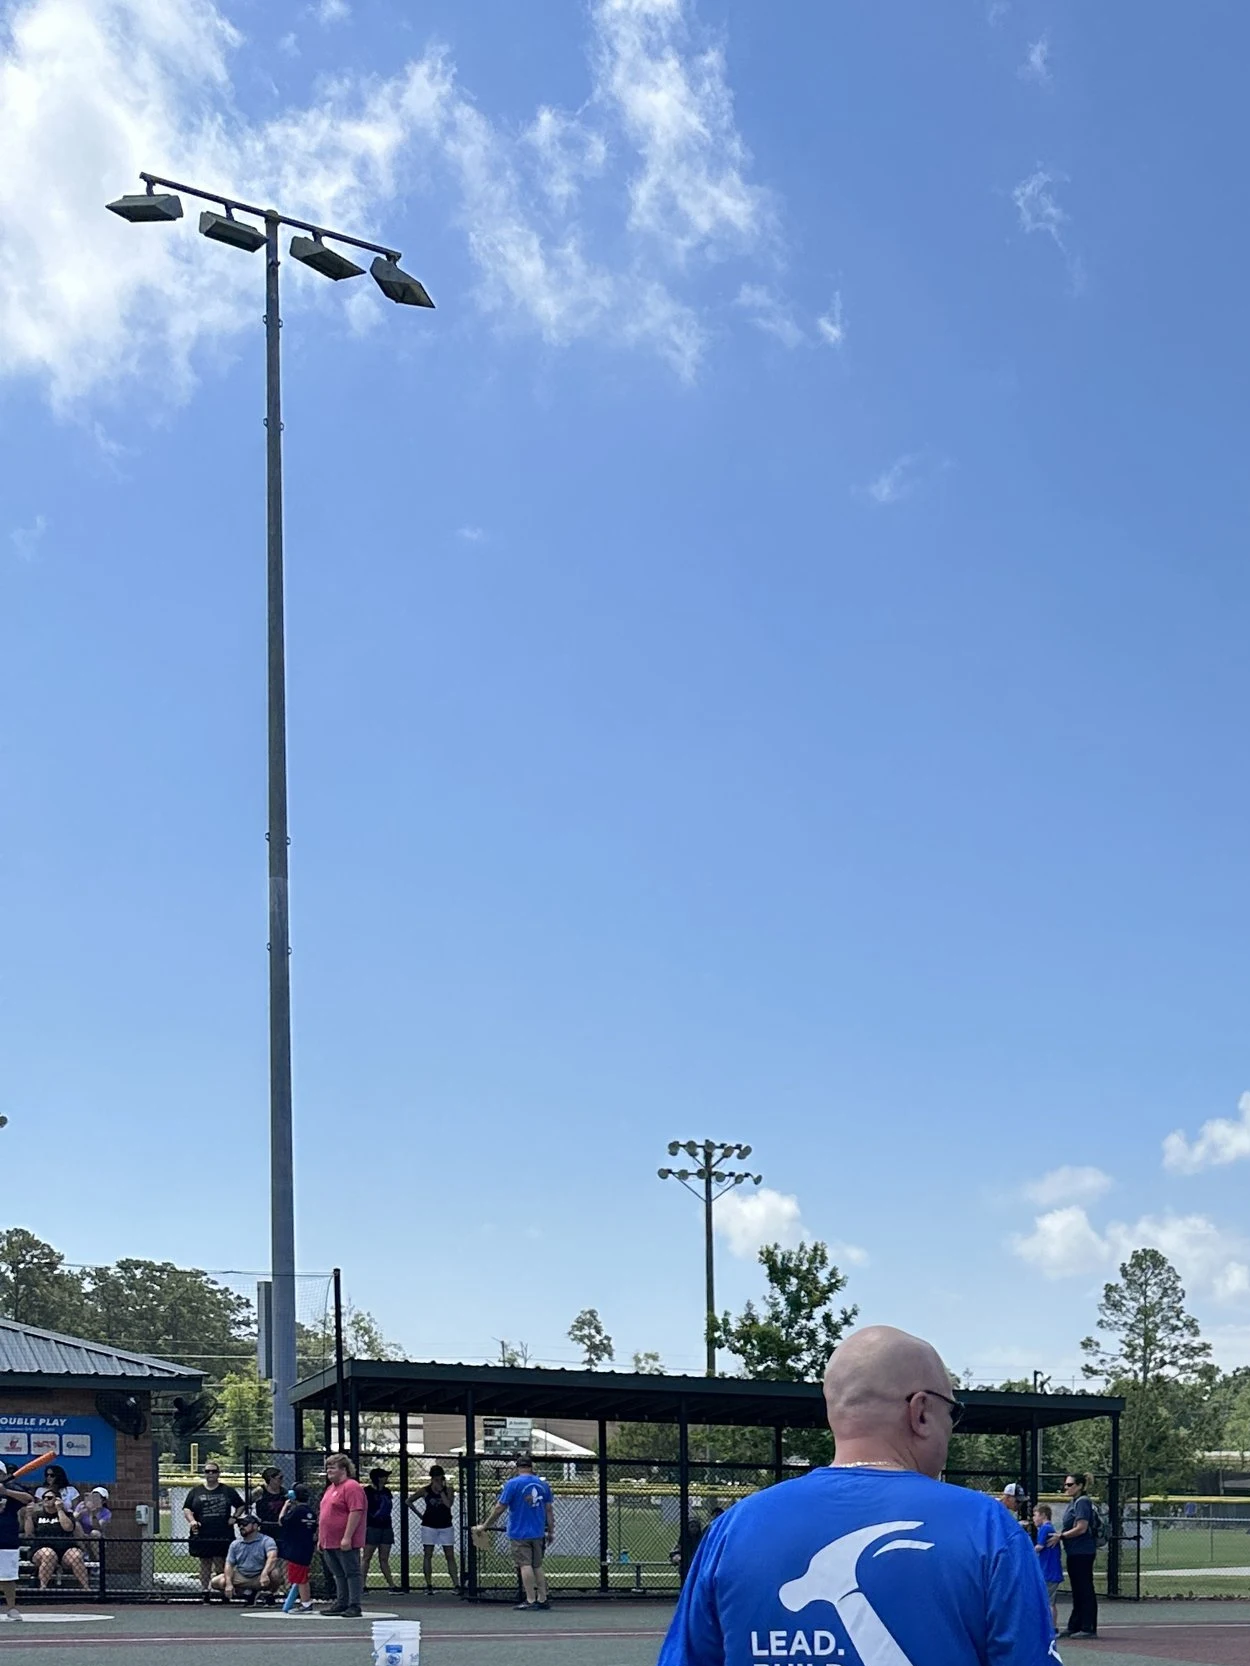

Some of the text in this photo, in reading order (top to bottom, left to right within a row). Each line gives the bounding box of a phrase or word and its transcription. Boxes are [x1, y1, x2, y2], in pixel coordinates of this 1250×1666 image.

[0, 1417, 67, 1427] OUBLE PLAY
[751, 1630, 845, 1656] LEAD.
